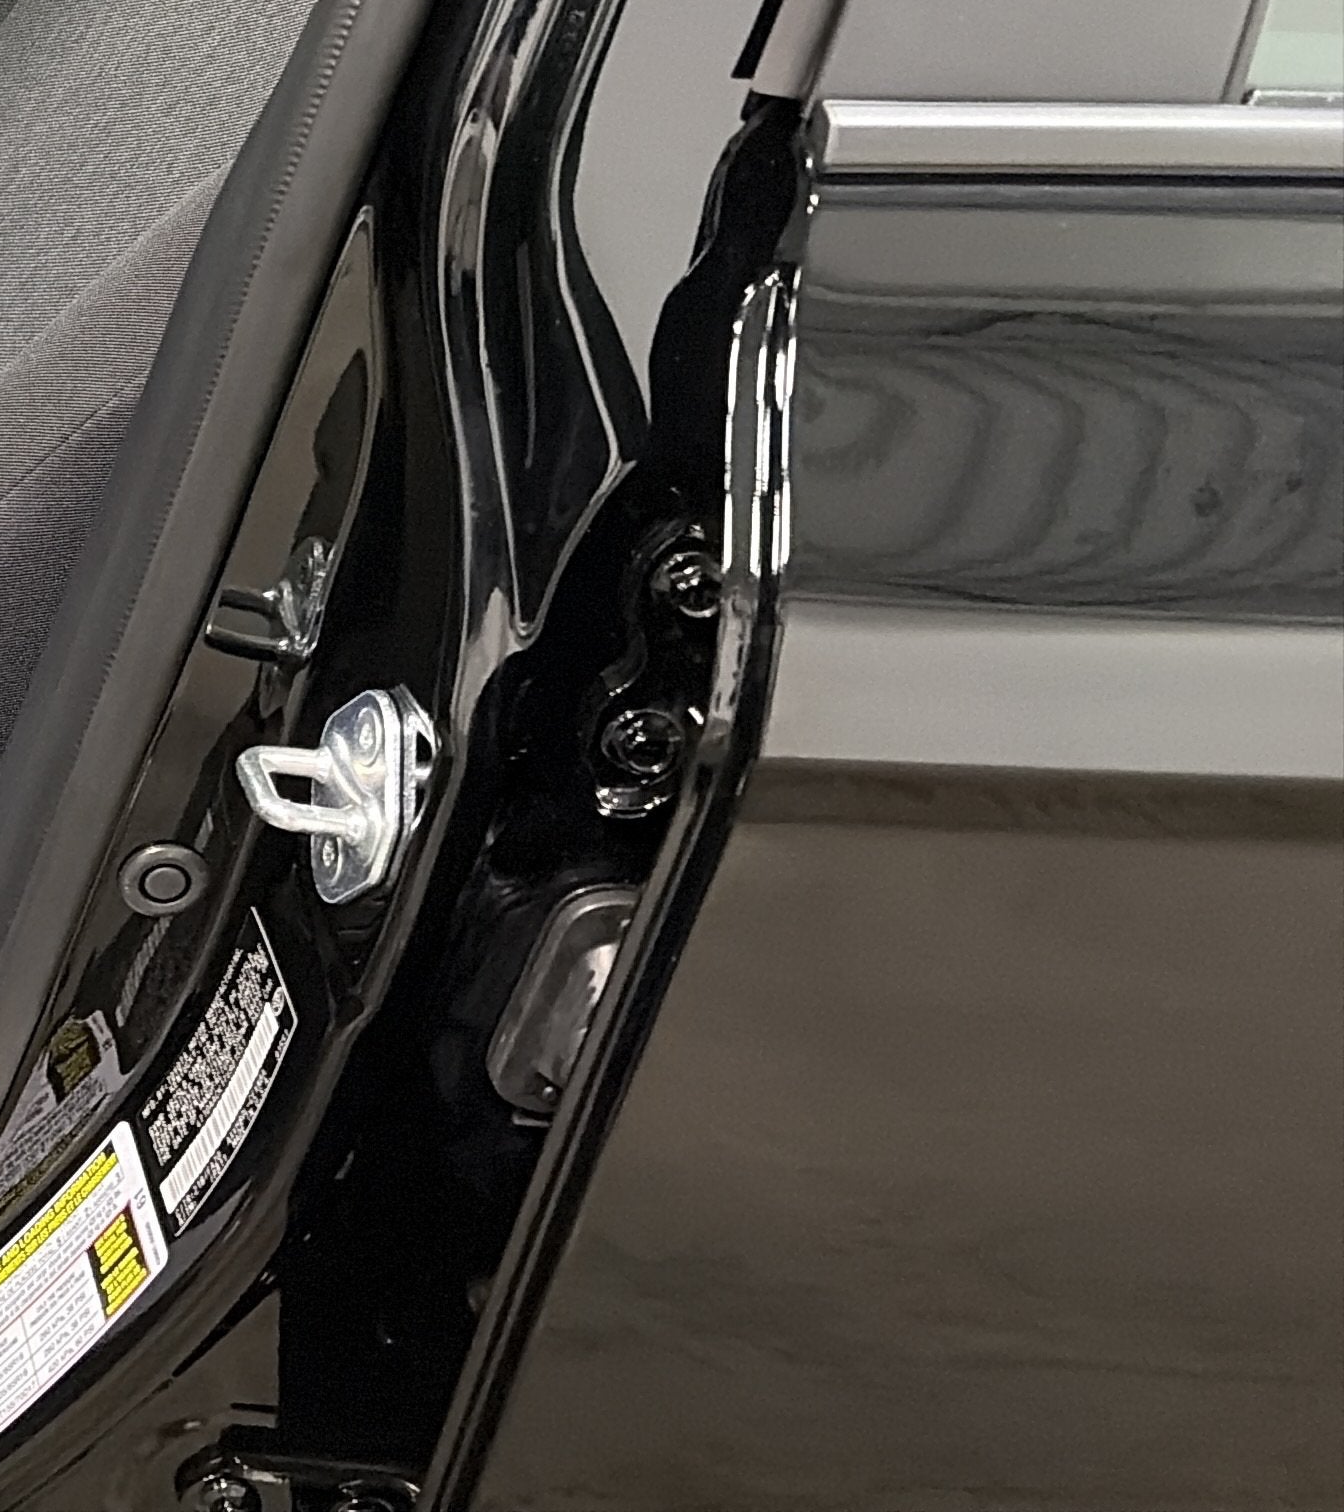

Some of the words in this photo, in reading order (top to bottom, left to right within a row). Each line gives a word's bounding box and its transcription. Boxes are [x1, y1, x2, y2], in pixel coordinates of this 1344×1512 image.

[1, 1242, 18, 1266] AND
[19, 1206, 53, 1248] LOADING
[54, 1151, 106, 1212] INFORMATION
